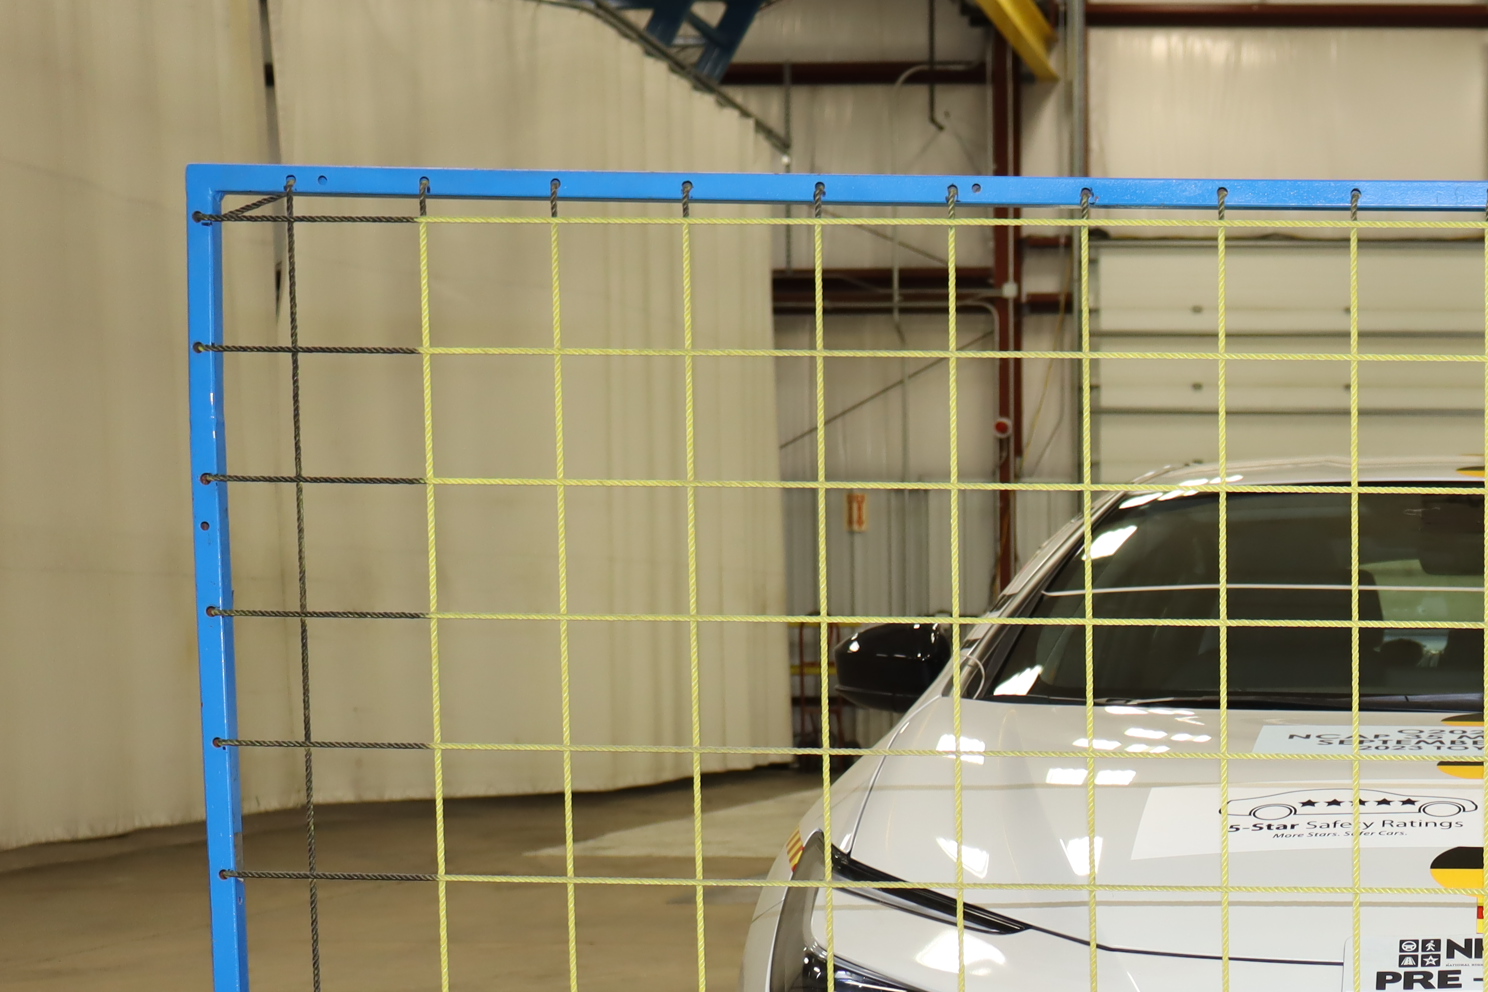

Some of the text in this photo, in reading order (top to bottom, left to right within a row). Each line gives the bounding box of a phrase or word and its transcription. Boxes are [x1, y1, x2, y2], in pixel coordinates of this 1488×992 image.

[1228, 819, 1464, 832] 5-Star Safey Ratings
[1375, 970, 1462, 990] PRE
